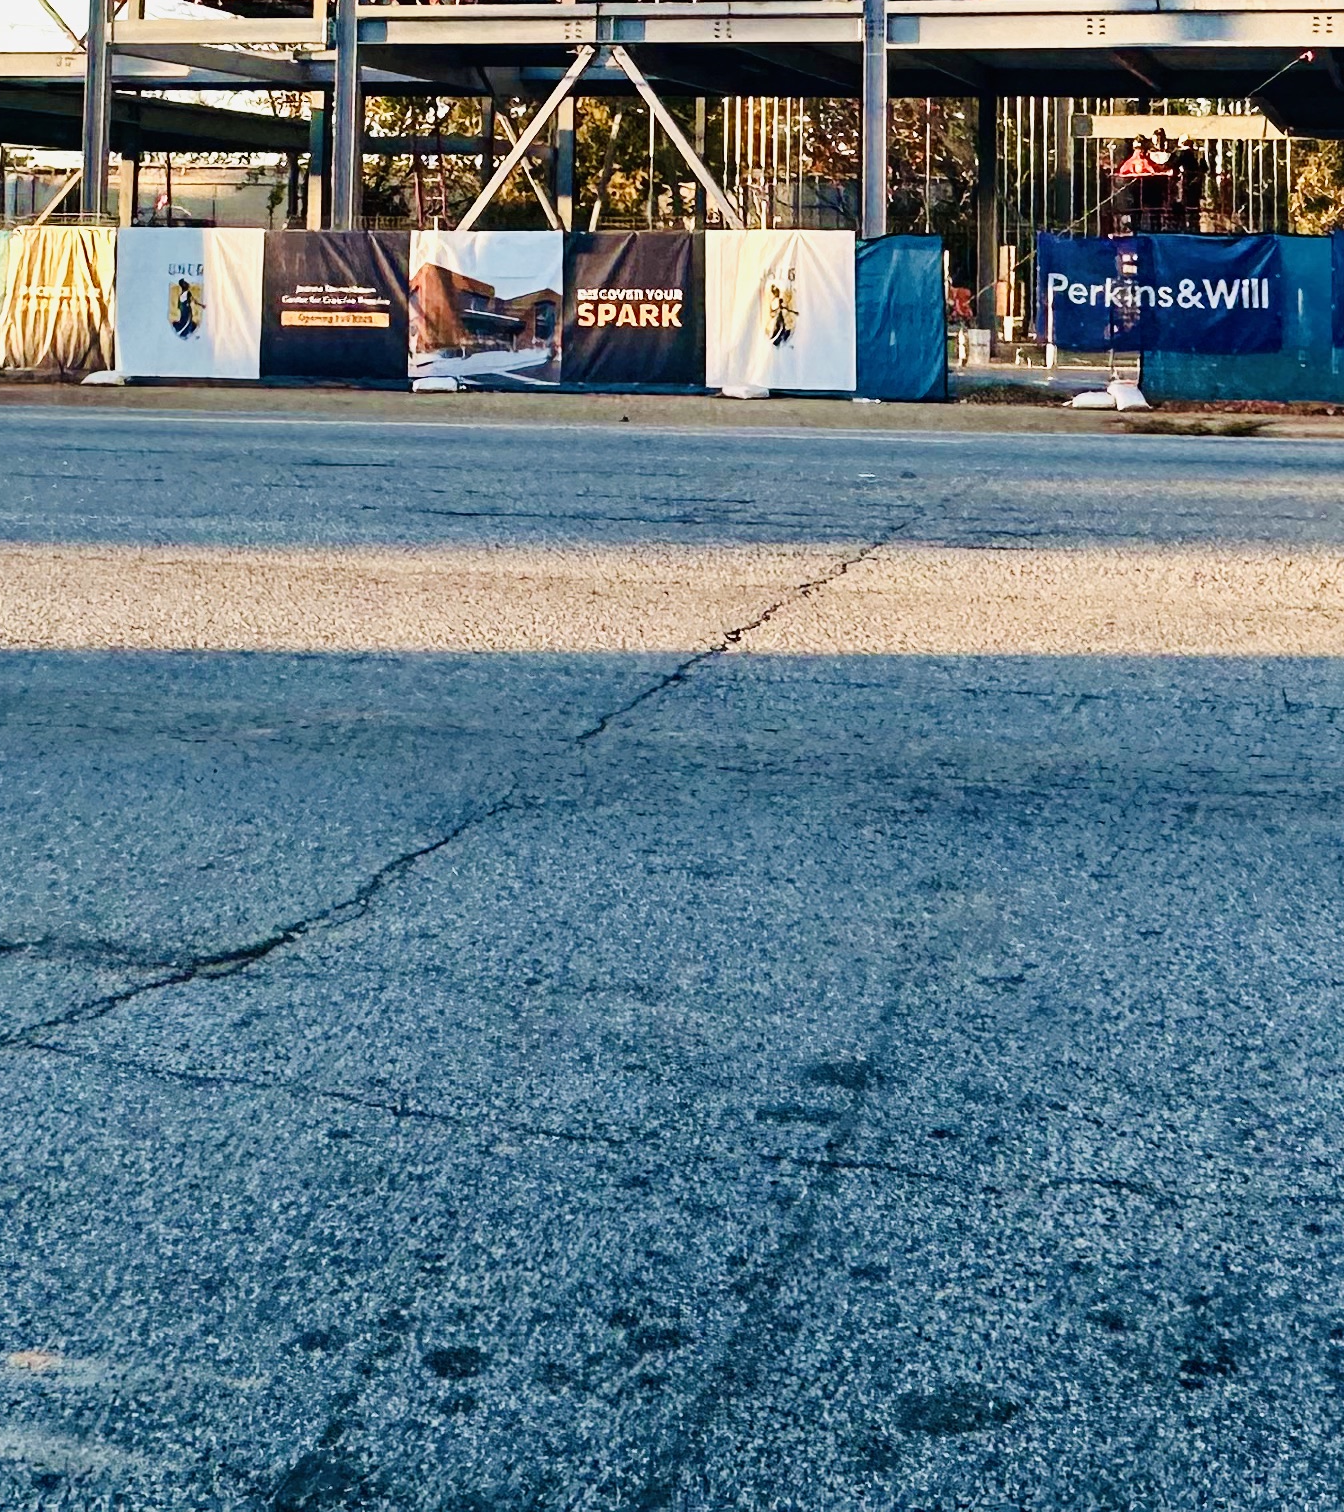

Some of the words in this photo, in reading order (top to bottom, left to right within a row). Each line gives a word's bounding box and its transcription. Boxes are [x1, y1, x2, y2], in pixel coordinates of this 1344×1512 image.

[577, 288, 644, 300] DISCOVER
[645, 289, 683, 300] YOUR
[1048, 273, 1269, 309] Perkins&Will
[577, 303, 683, 327] SPARK
